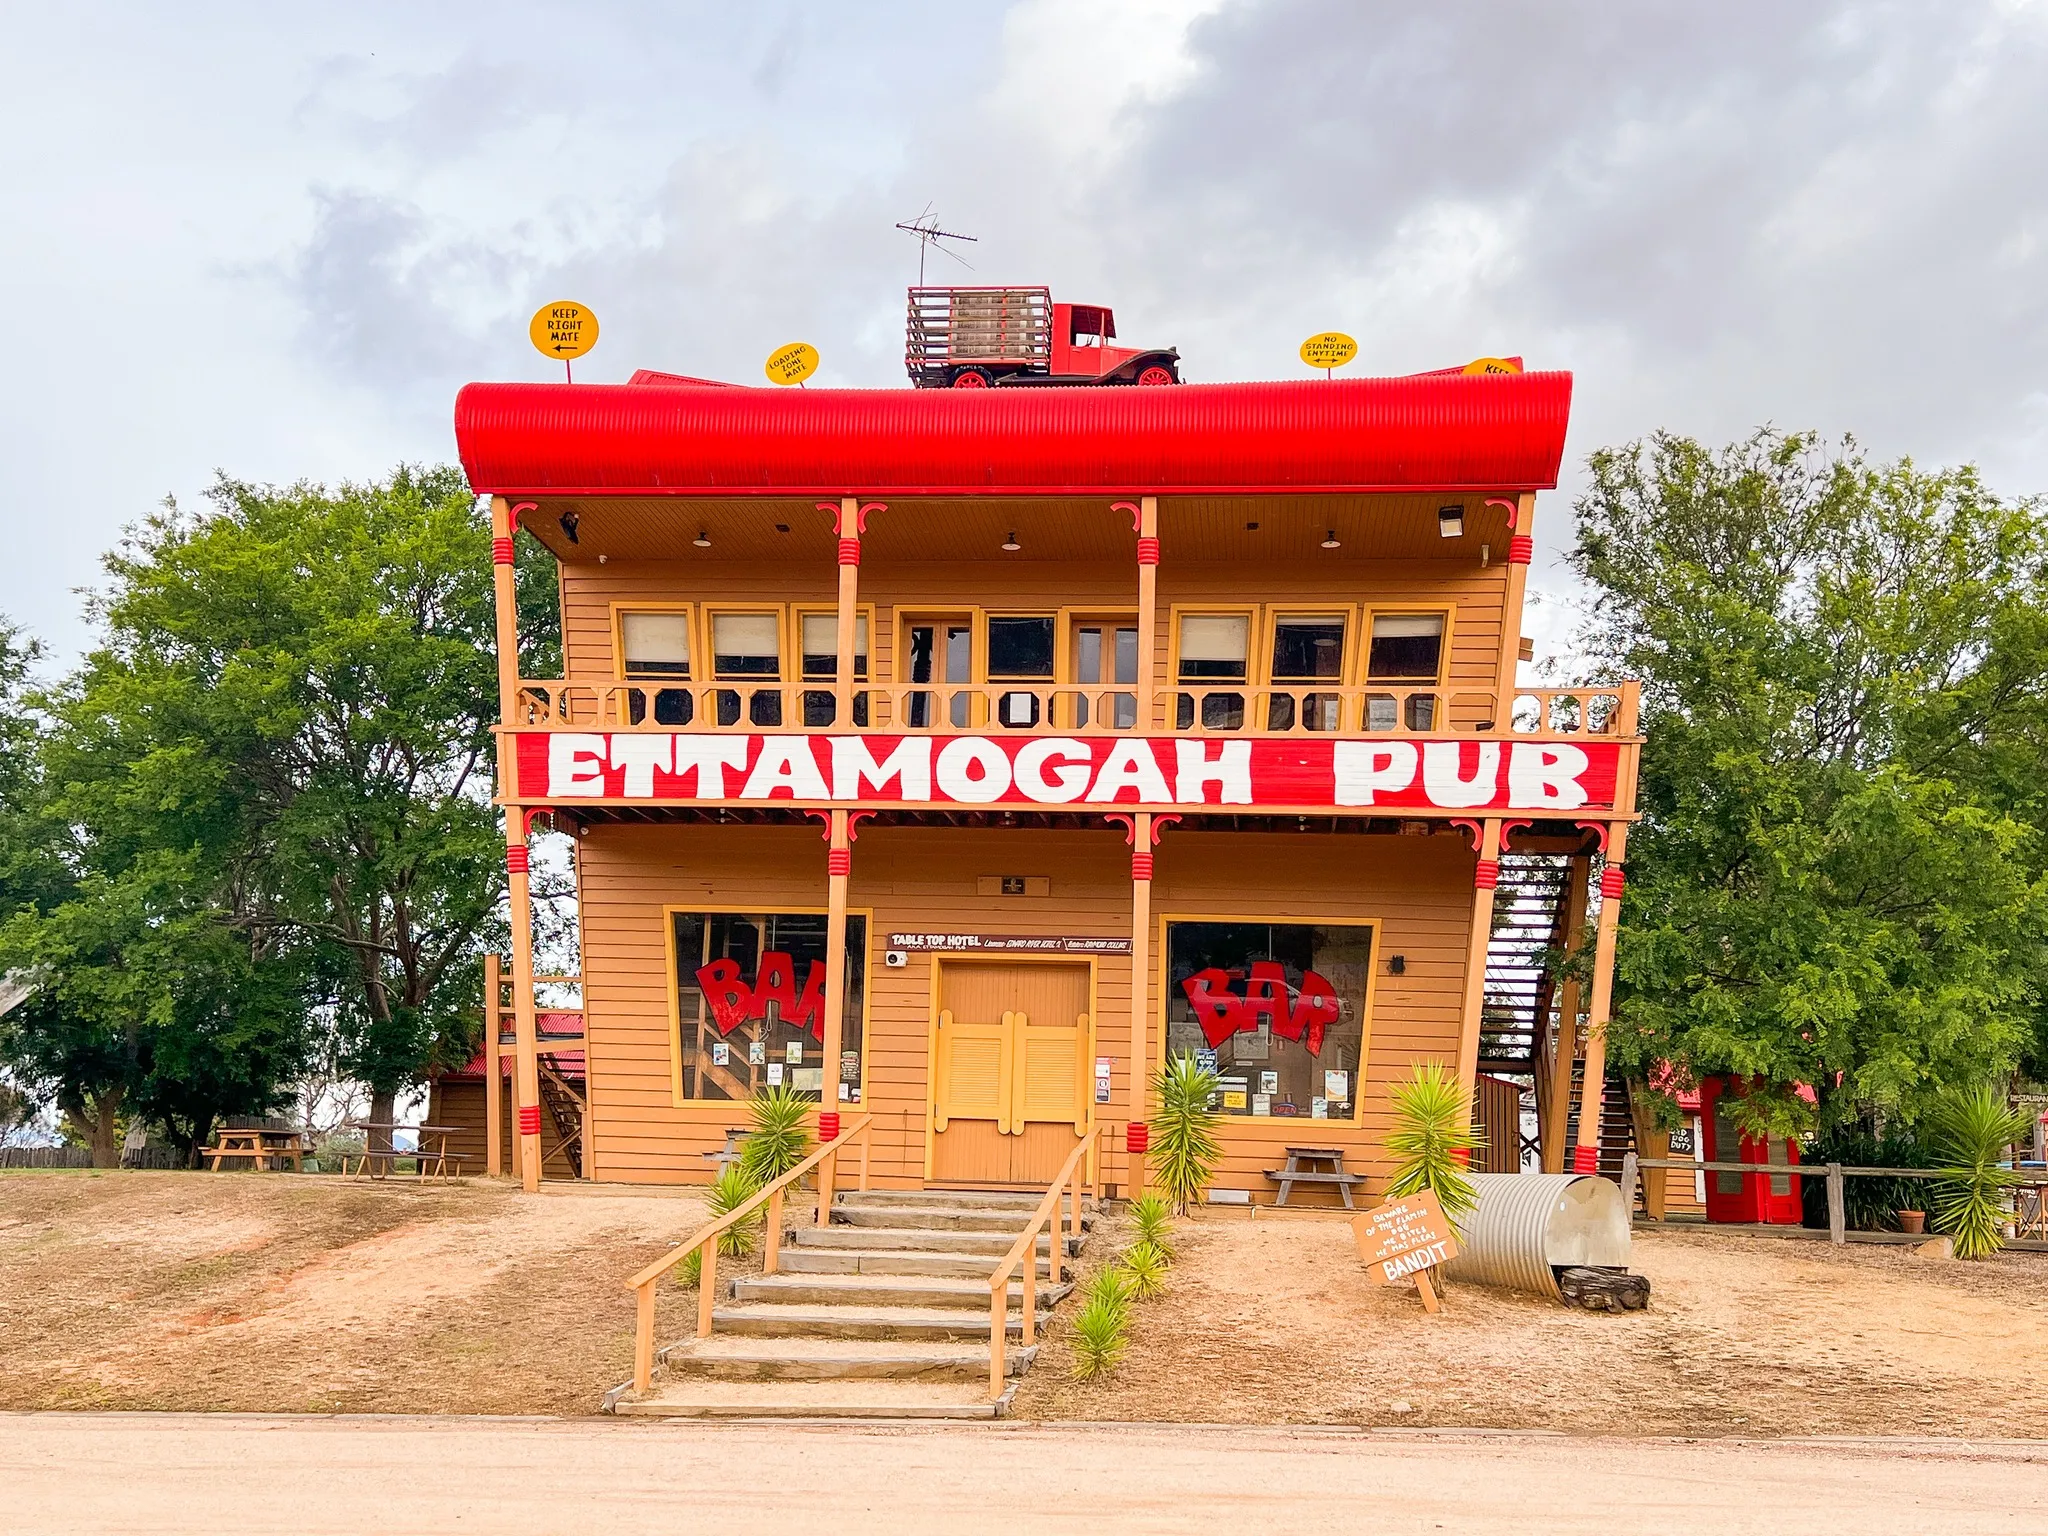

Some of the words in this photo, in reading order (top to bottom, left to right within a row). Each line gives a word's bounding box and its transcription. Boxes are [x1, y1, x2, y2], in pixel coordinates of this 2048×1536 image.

[552, 308, 578, 320] KEEP
[547, 320, 582, 331] RIGHT
[550, 331, 579, 342] MATE
[769, 345, 806, 369] LOADING
[781, 357, 802, 372] ZONE
[785, 363, 807, 379] MATE
[547, 732, 1253, 806] ETTAMOGAH
[1333, 740, 1590, 810] PUB
[891, 934, 925, 945] TABLE
[925, 935, 946, 946] TOP
[947, 935, 981, 947] HOTEL
[1181, 960, 1340, 1059] BAR
[1671, 1141, 1691, 1151] DUTY
[1672, 1135, 1690, 1143] DOG
[1372, 1204, 1409, 1223] BEWARE
[1365, 1226, 1376, 1237] OF
[1378, 1220, 1393, 1231] THE
[1391, 1222, 1409, 1235] DOG
[1375, 1248, 1388, 1258] HE
[1391, 1240, 1409, 1252] HAS
[1411, 1231, 1437, 1246] FLEAS
[1382, 1240, 1447, 1281] BANDIT
